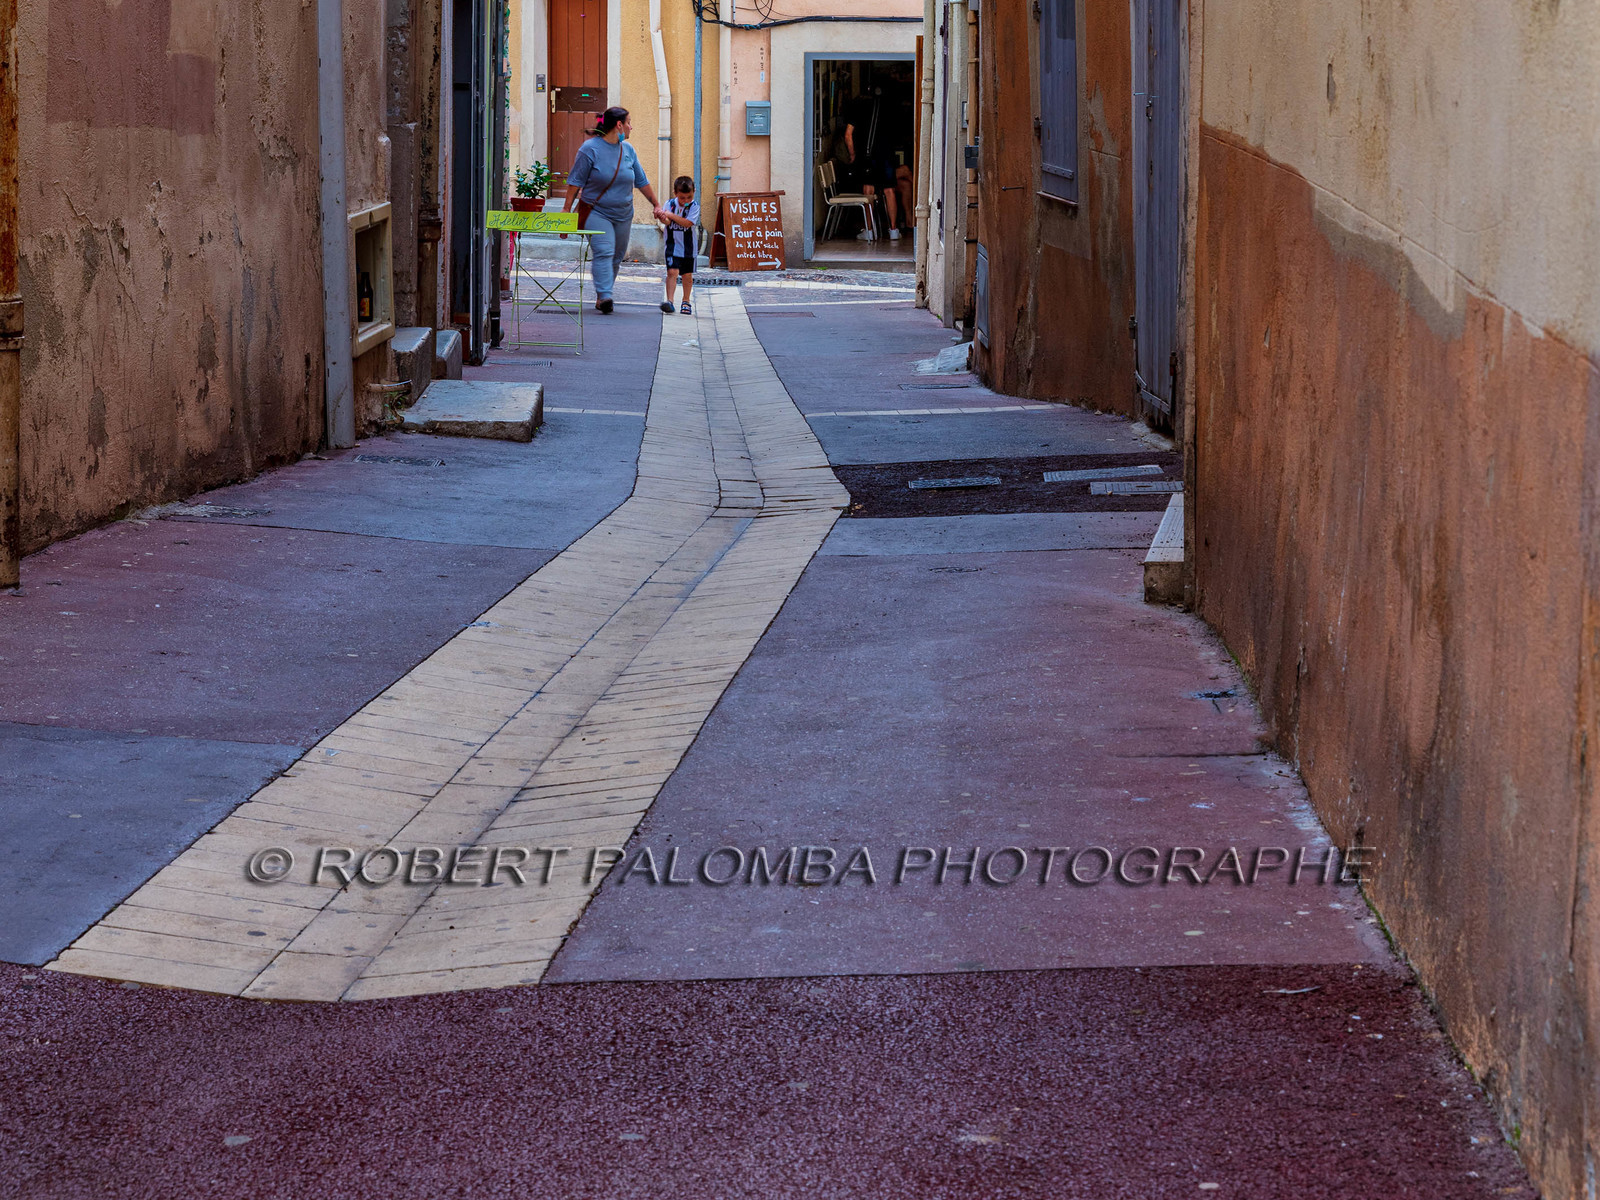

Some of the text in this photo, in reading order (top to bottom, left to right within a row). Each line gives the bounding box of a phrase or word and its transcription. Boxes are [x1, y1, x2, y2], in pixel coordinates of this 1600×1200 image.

[731, 224, 784, 241] Four à pain
[736, 250, 773, 259] entrée libre
